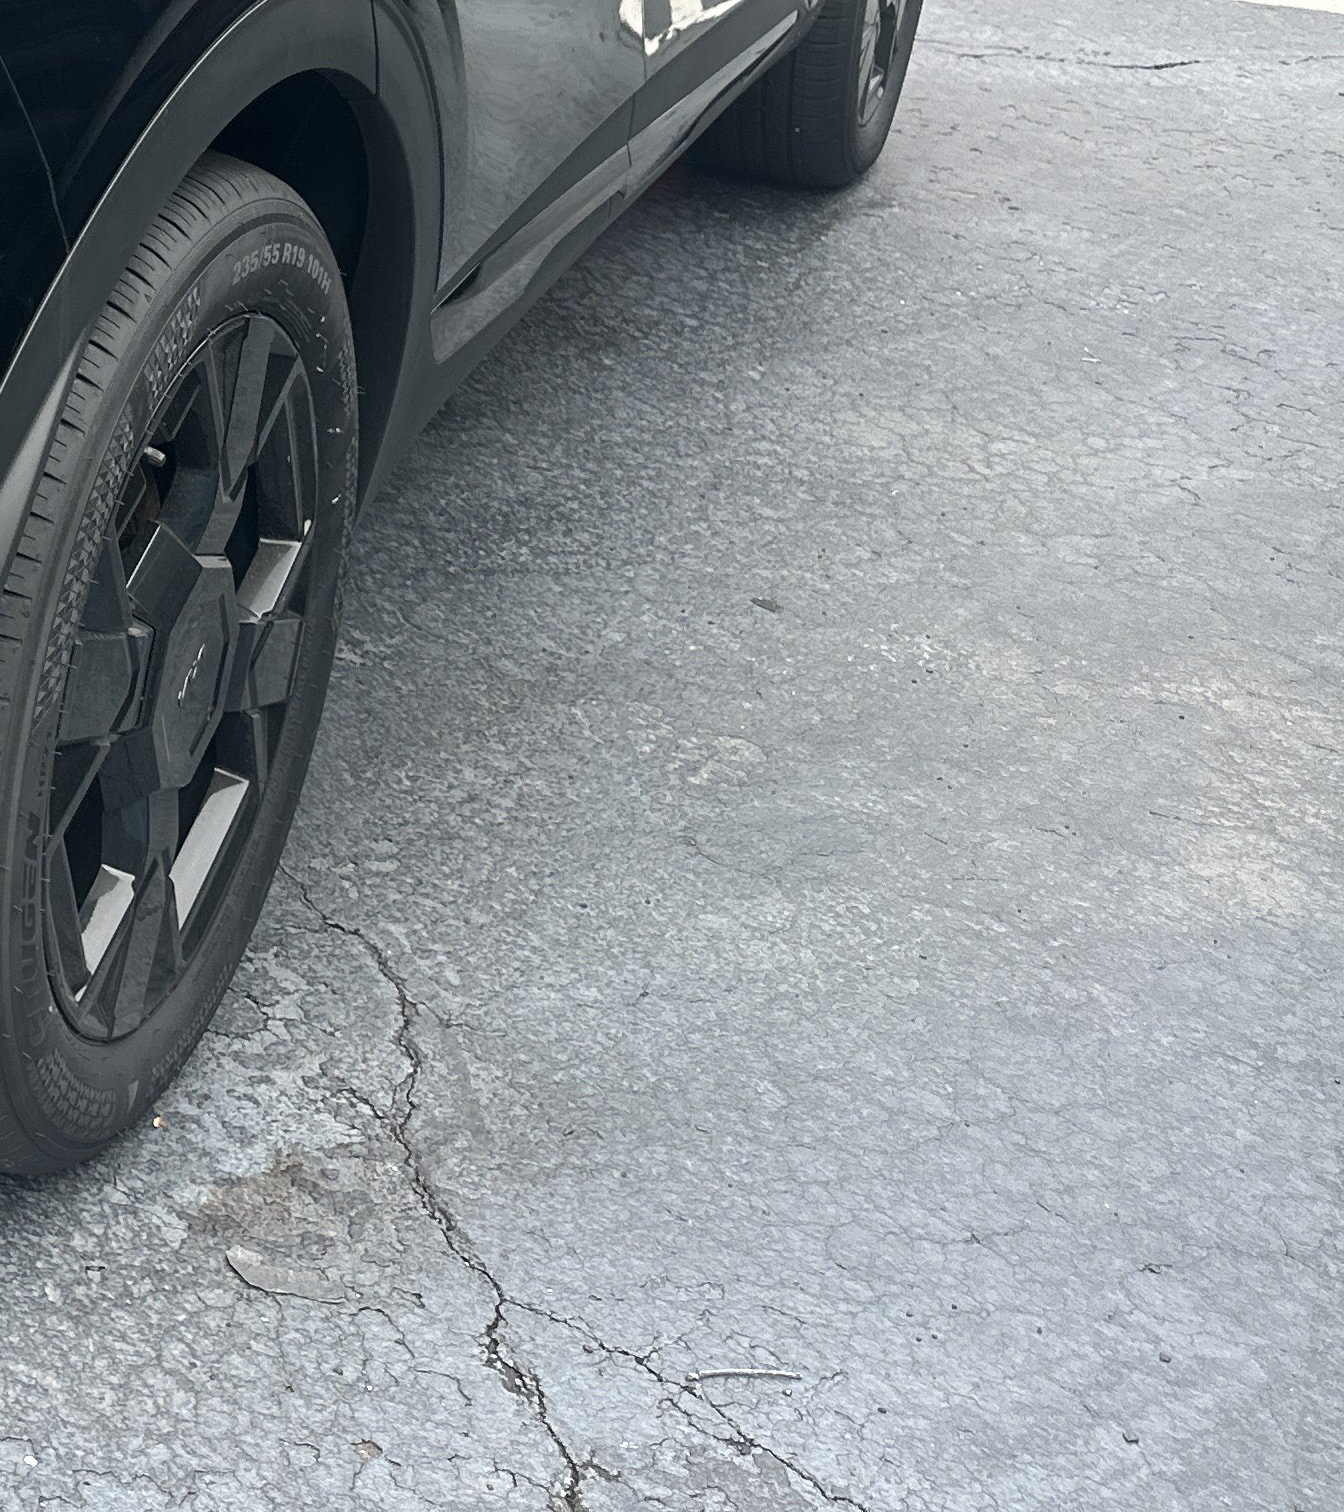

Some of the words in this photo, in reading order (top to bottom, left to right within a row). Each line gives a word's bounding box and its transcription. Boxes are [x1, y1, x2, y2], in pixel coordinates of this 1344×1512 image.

[232, 242, 281, 287] 235/55
[281, 242, 306, 268] R19
[307, 254, 332, 295] 101H
